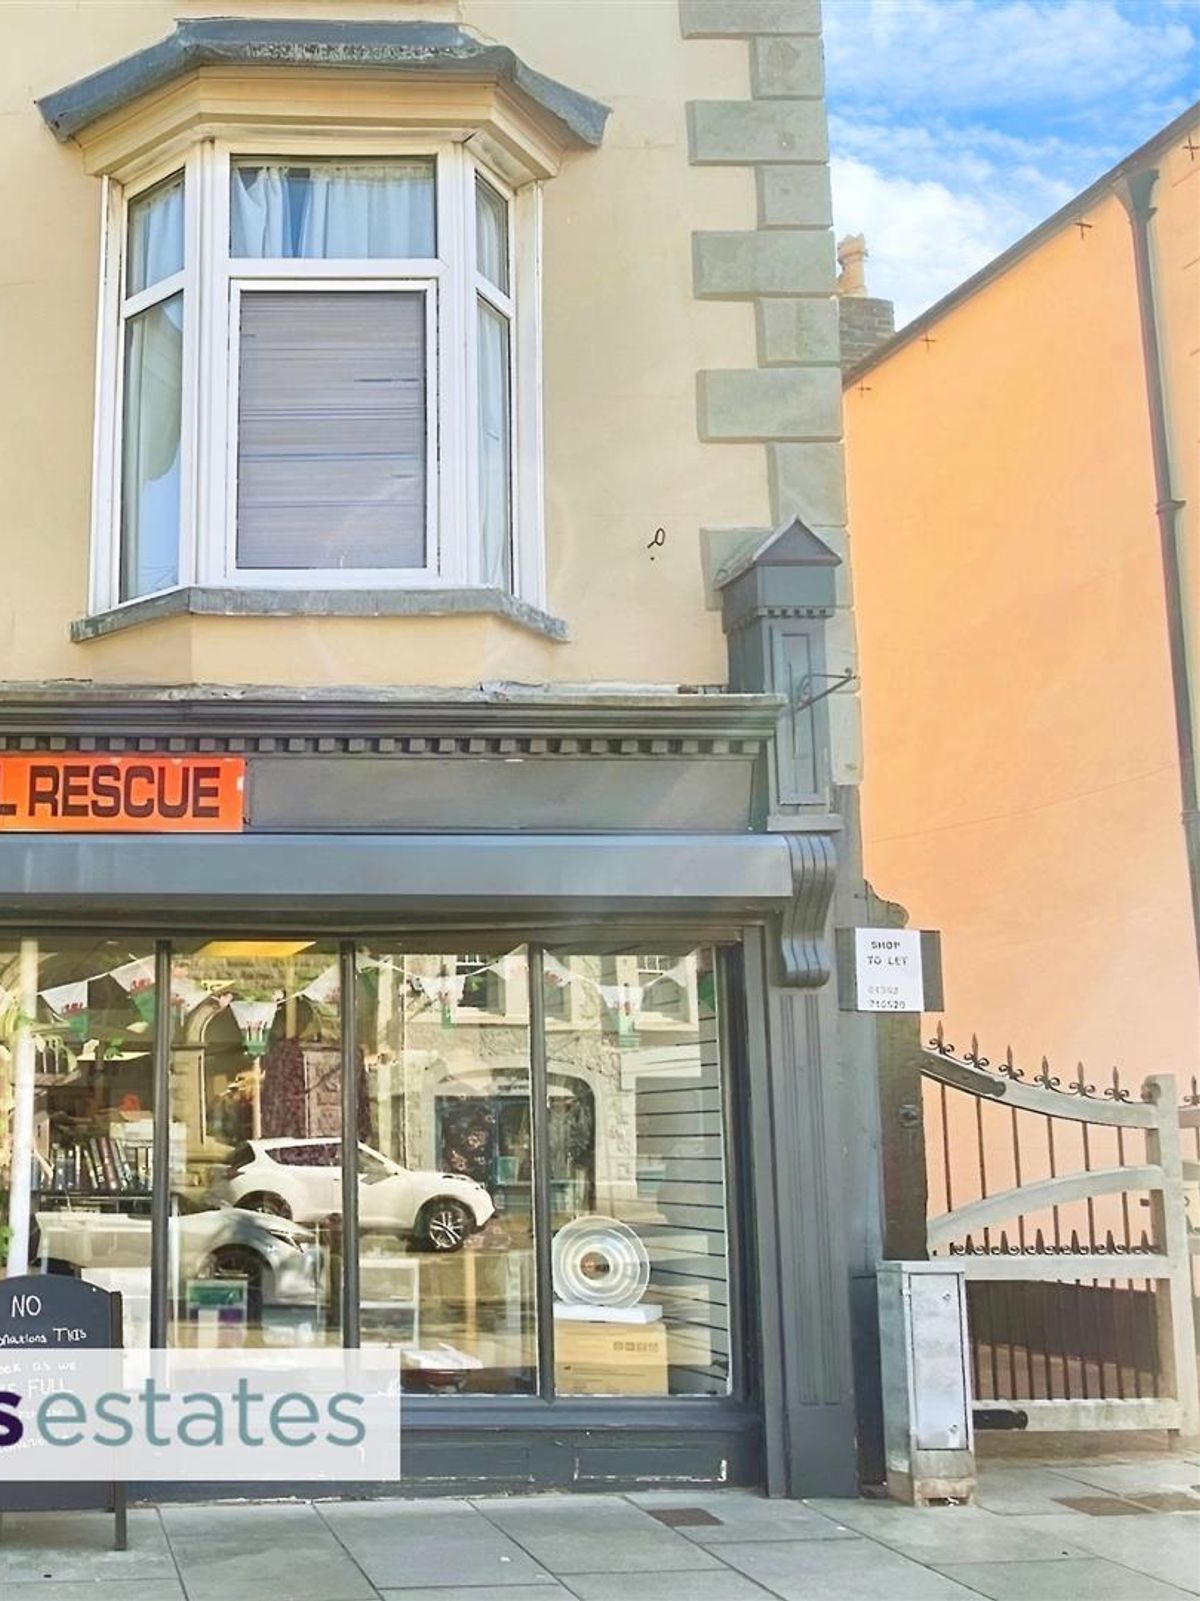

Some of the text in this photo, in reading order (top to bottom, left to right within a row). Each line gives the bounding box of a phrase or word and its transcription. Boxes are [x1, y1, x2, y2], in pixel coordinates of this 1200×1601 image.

[29, 765, 221, 819] RESCUE
[871, 941, 900, 950] SHOP
[867, 955, 908, 966] TO LET
[11, 1294, 42, 1318] NO
[28, 1377, 74, 1401] FULL
